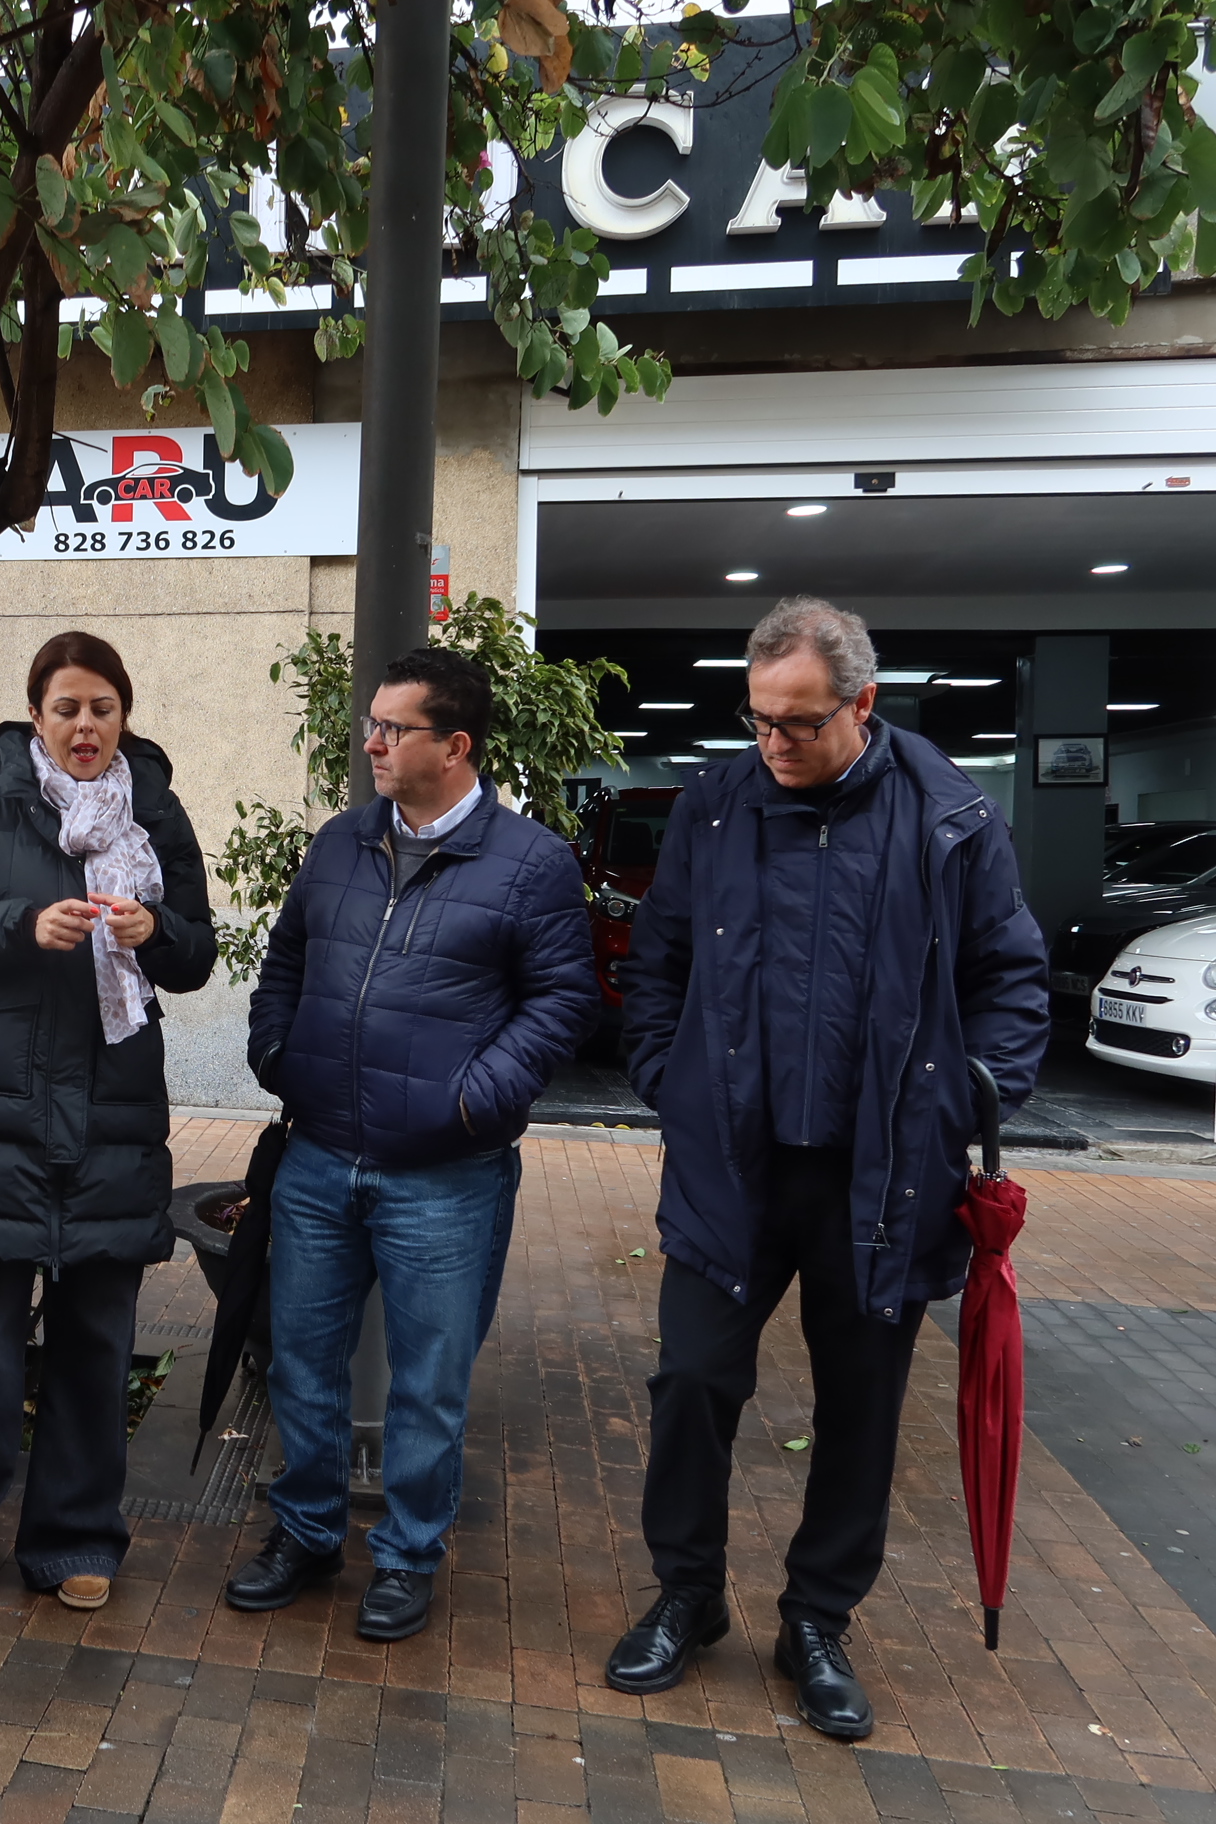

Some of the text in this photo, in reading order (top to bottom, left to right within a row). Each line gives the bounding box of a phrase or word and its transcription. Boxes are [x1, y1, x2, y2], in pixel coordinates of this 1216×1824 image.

[117, 478, 173, 499] CAR
[53, 529, 236, 553] 828 736 826
[1103, 1000, 1145, 1023] 6855 KKV
